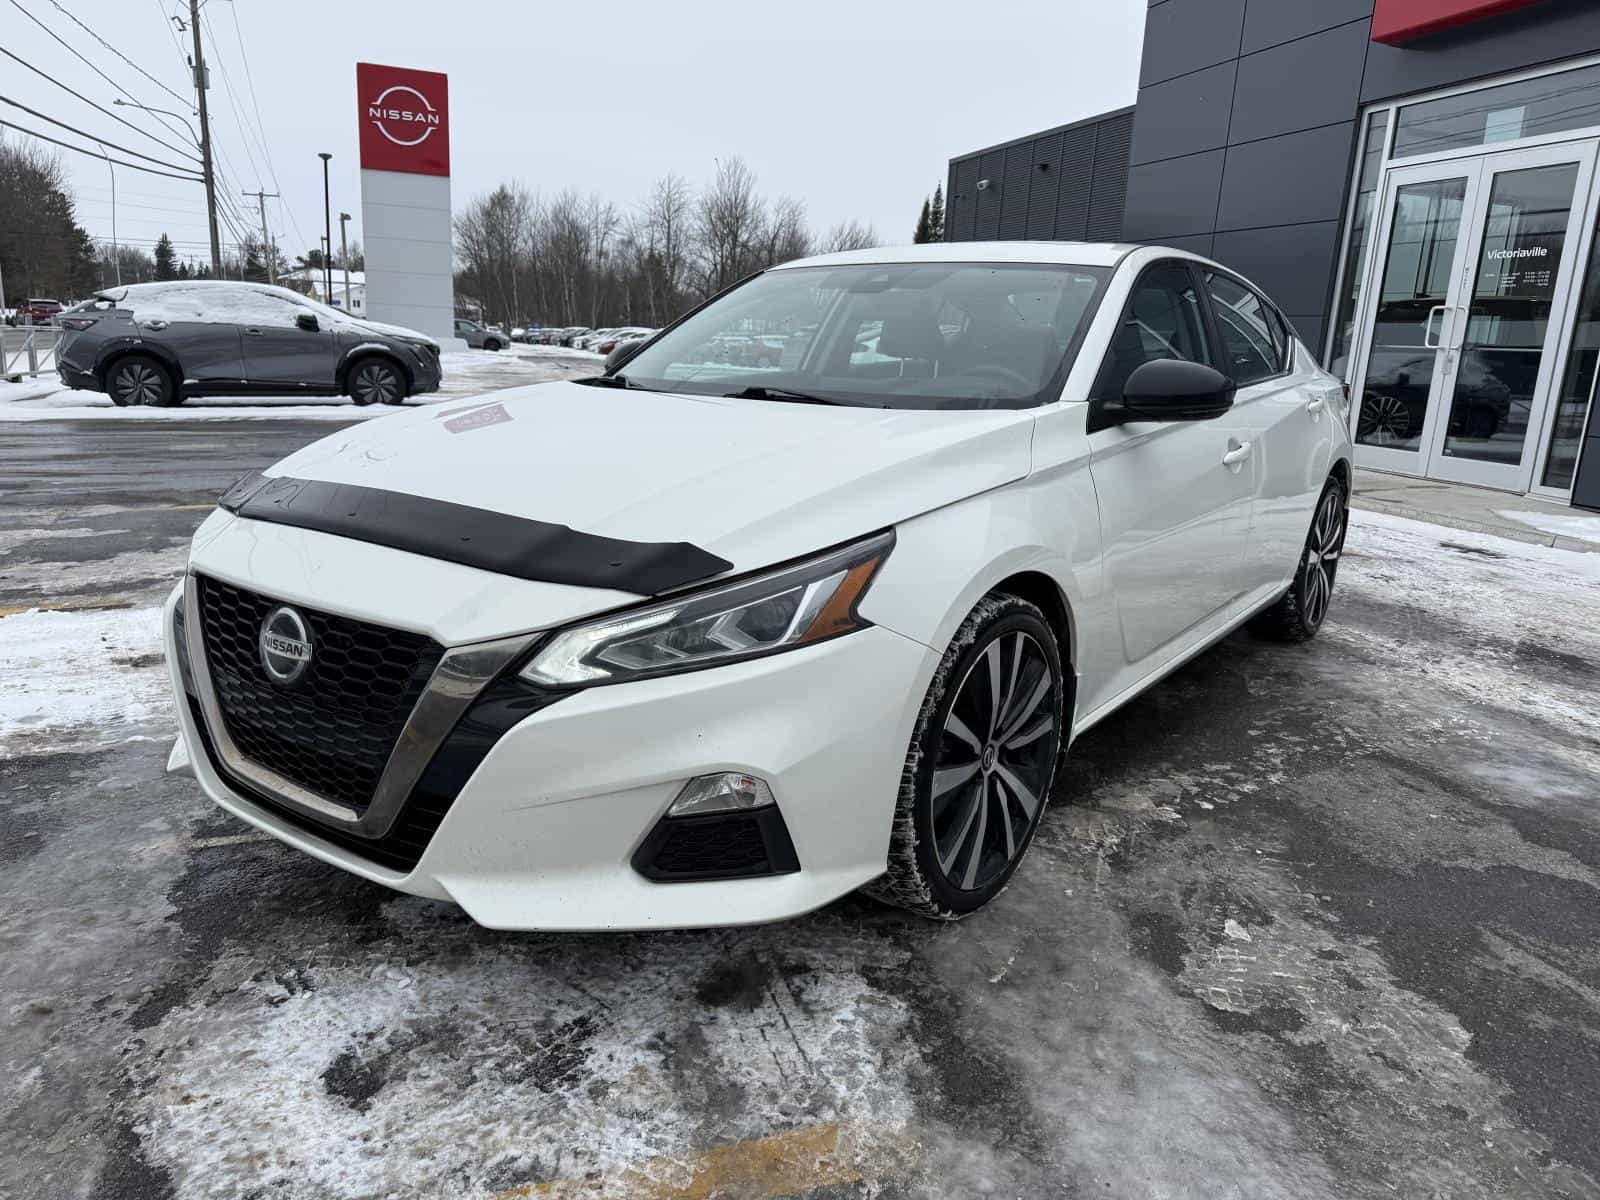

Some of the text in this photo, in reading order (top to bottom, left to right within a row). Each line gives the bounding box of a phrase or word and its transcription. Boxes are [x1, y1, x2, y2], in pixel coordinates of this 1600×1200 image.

[368, 107, 439, 124] NISSAN
[1487, 246, 1548, 260] Victoriaville
[265, 634, 303, 657] NISSAN
